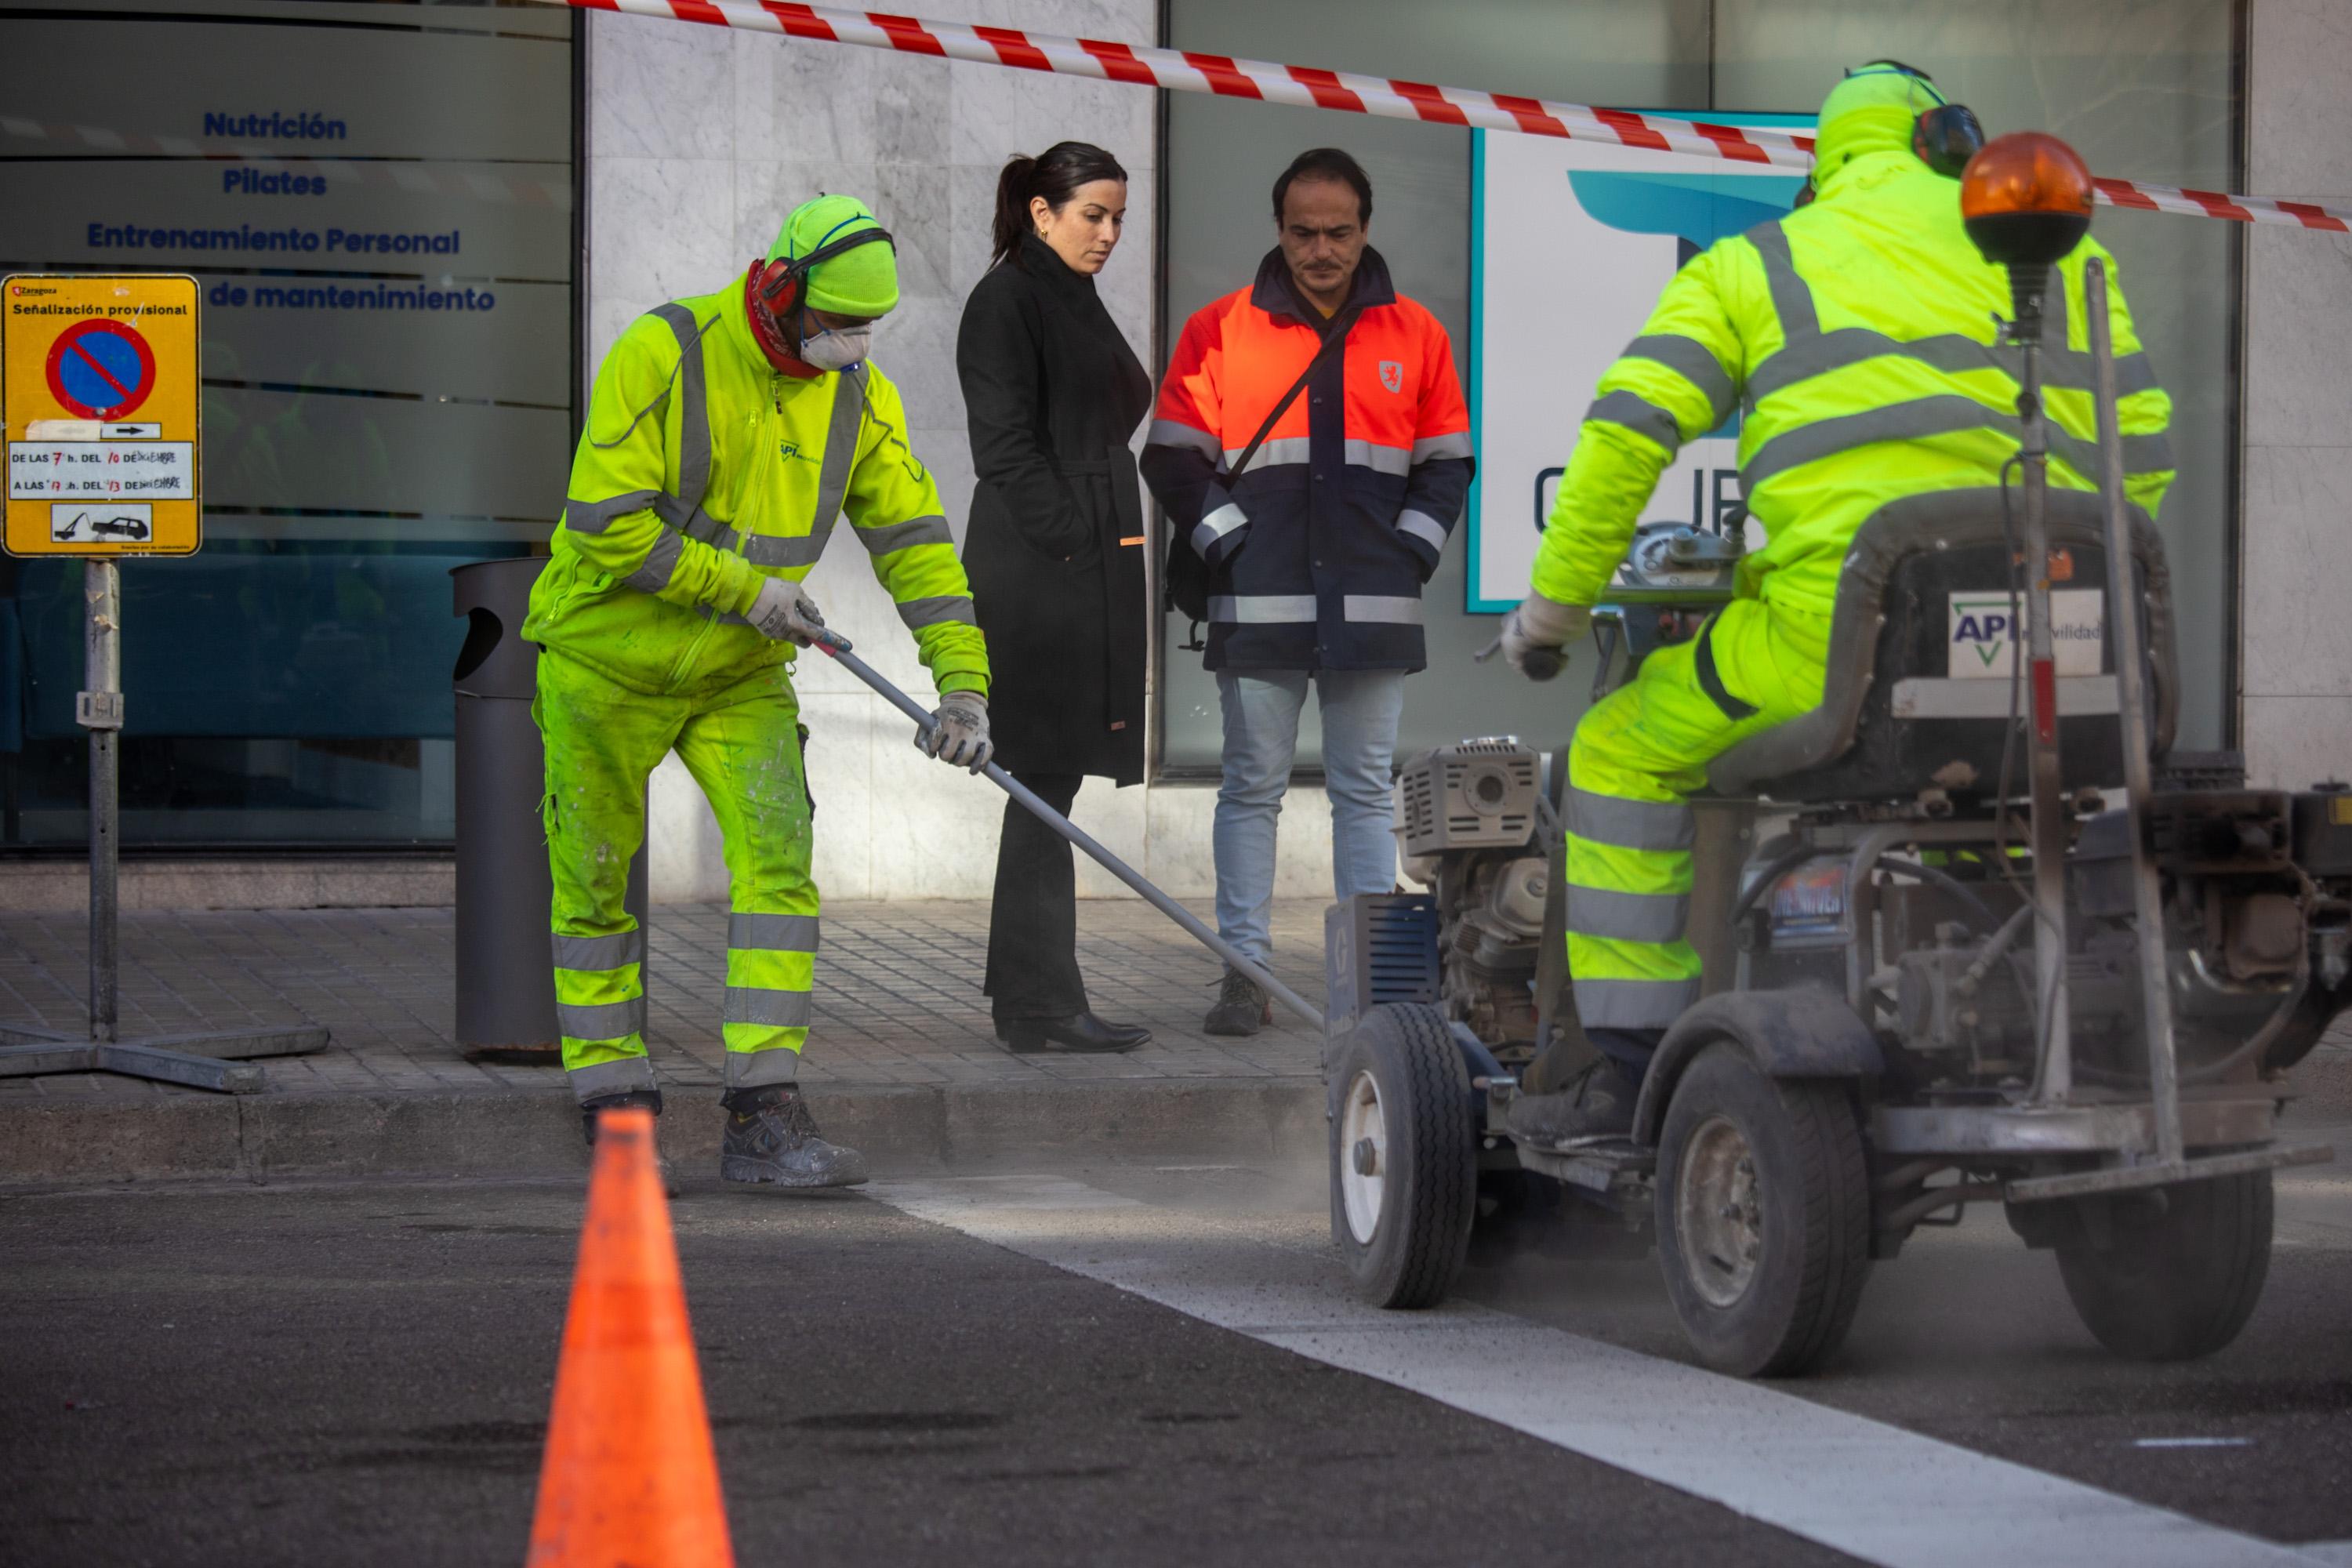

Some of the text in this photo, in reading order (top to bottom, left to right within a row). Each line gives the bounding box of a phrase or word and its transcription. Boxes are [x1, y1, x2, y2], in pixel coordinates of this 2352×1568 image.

[204, 111, 347, 140] Nutrición
[223, 168, 328, 195] Pilates
[87, 223, 461, 254] Entrenamiento Personal
[21, 287, 57, 296] Zaragoza
[209, 281, 495, 312] de mantenimiento
[13, 303, 187, 317] Señalización provisional
[12, 454, 26, 463] DE
[29, 454, 49, 463] LAS
[52, 452, 63, 466] 7
[82, 454, 101, 463] DEL
[123, 454, 136, 463] DE
[14, 481, 22, 490] A
[24, 481, 45, 490] LAS
[82, 481, 103, 490] DEL
[125, 481, 138, 490] DE
